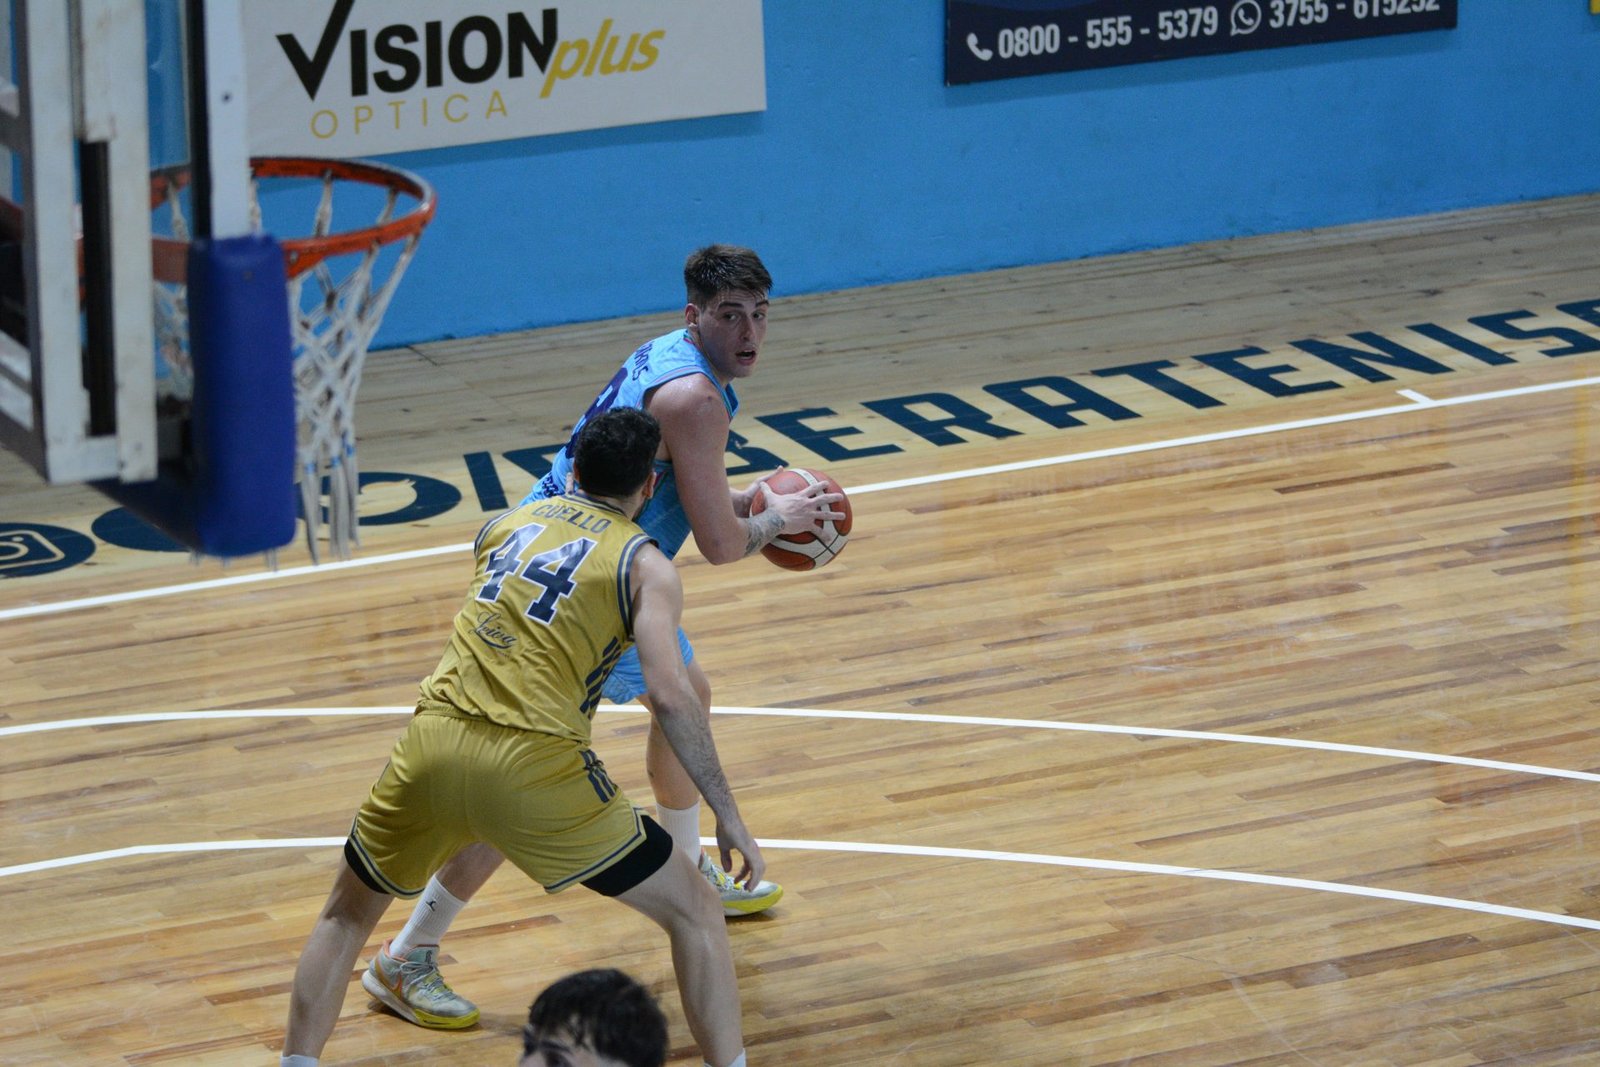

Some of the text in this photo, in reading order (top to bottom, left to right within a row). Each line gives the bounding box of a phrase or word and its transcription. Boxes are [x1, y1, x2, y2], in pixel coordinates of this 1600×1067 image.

[997, 23, 1060, 59] 0800
[1085, 15, 1133, 49] 555
[1157, 6, 1219, 41] 5379
[1269, 0, 1329, 28] 3755
[310, 90, 508, 139] OPTICA
[531, 503, 612, 534] CUELLO
[475, 522, 599, 625] 44
